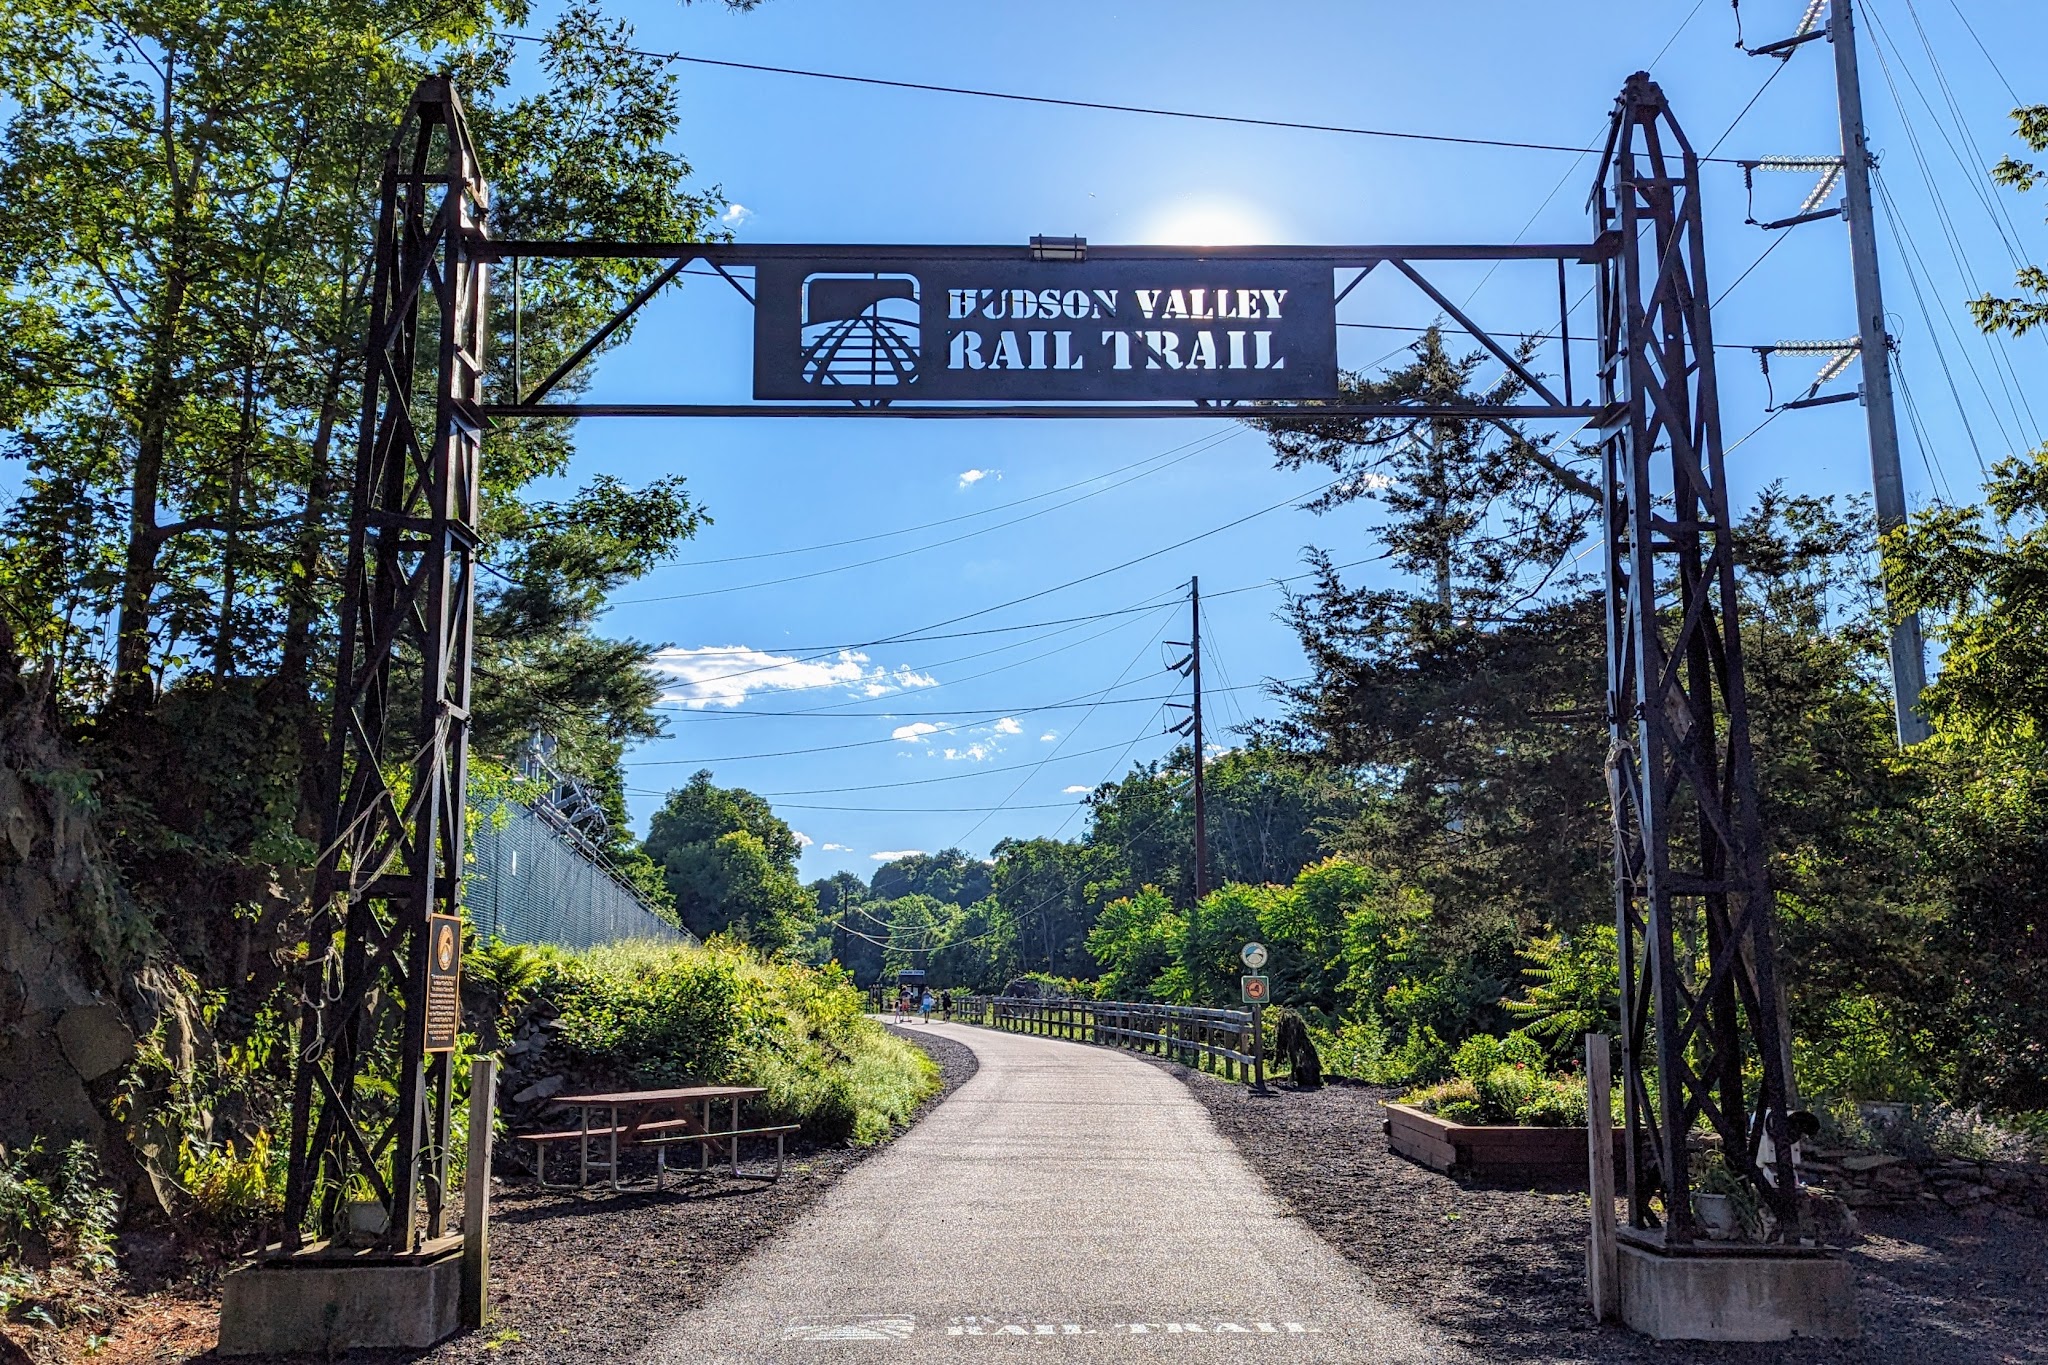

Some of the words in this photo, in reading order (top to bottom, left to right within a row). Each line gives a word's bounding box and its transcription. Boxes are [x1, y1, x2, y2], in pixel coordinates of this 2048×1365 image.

[948, 289, 1118, 319] HUDSON
[1134, 289, 1288, 319] VALLEY
[947, 330, 1083, 370] RAIL
[1102, 330, 1285, 370] TRAIL
[946, 1324, 1098, 1336] RAIL
[1114, 1322, 1322, 1334] TRAIL
